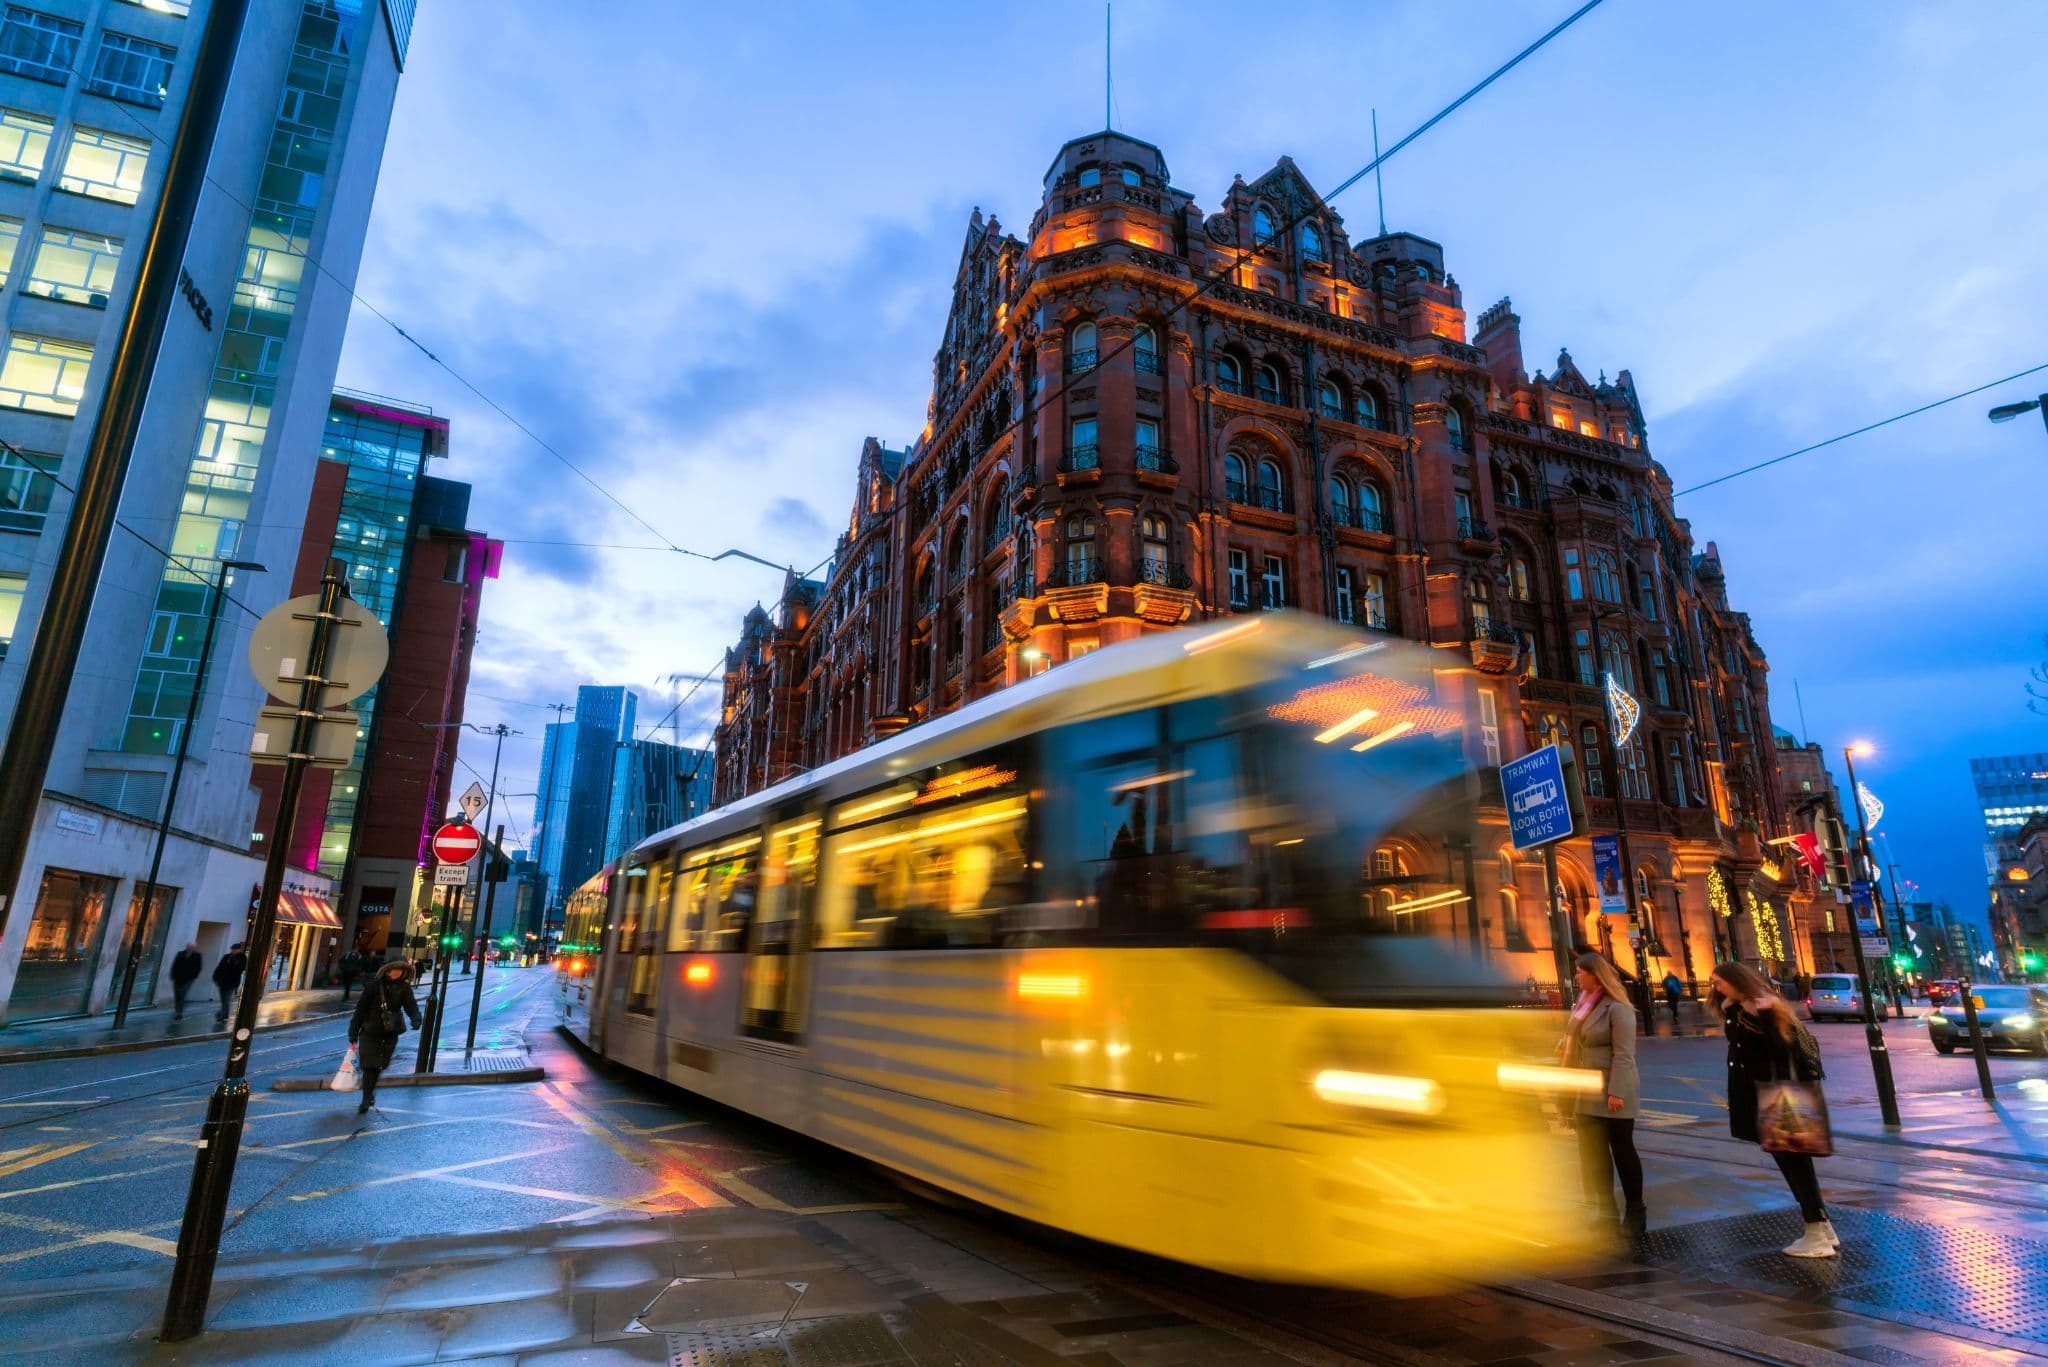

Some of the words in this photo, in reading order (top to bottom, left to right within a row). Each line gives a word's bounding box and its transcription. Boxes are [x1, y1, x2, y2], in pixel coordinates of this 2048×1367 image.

[1507, 753, 1550, 779] TRAMWAY
[466, 796, 482, 807] 15
[1513, 815, 1537, 831] LOOK
[1539, 804, 1565, 822] BOTH
[1528, 822, 1553, 840] WAYS
[439, 867, 466, 876] Except
[439, 875, 462, 883] trams
